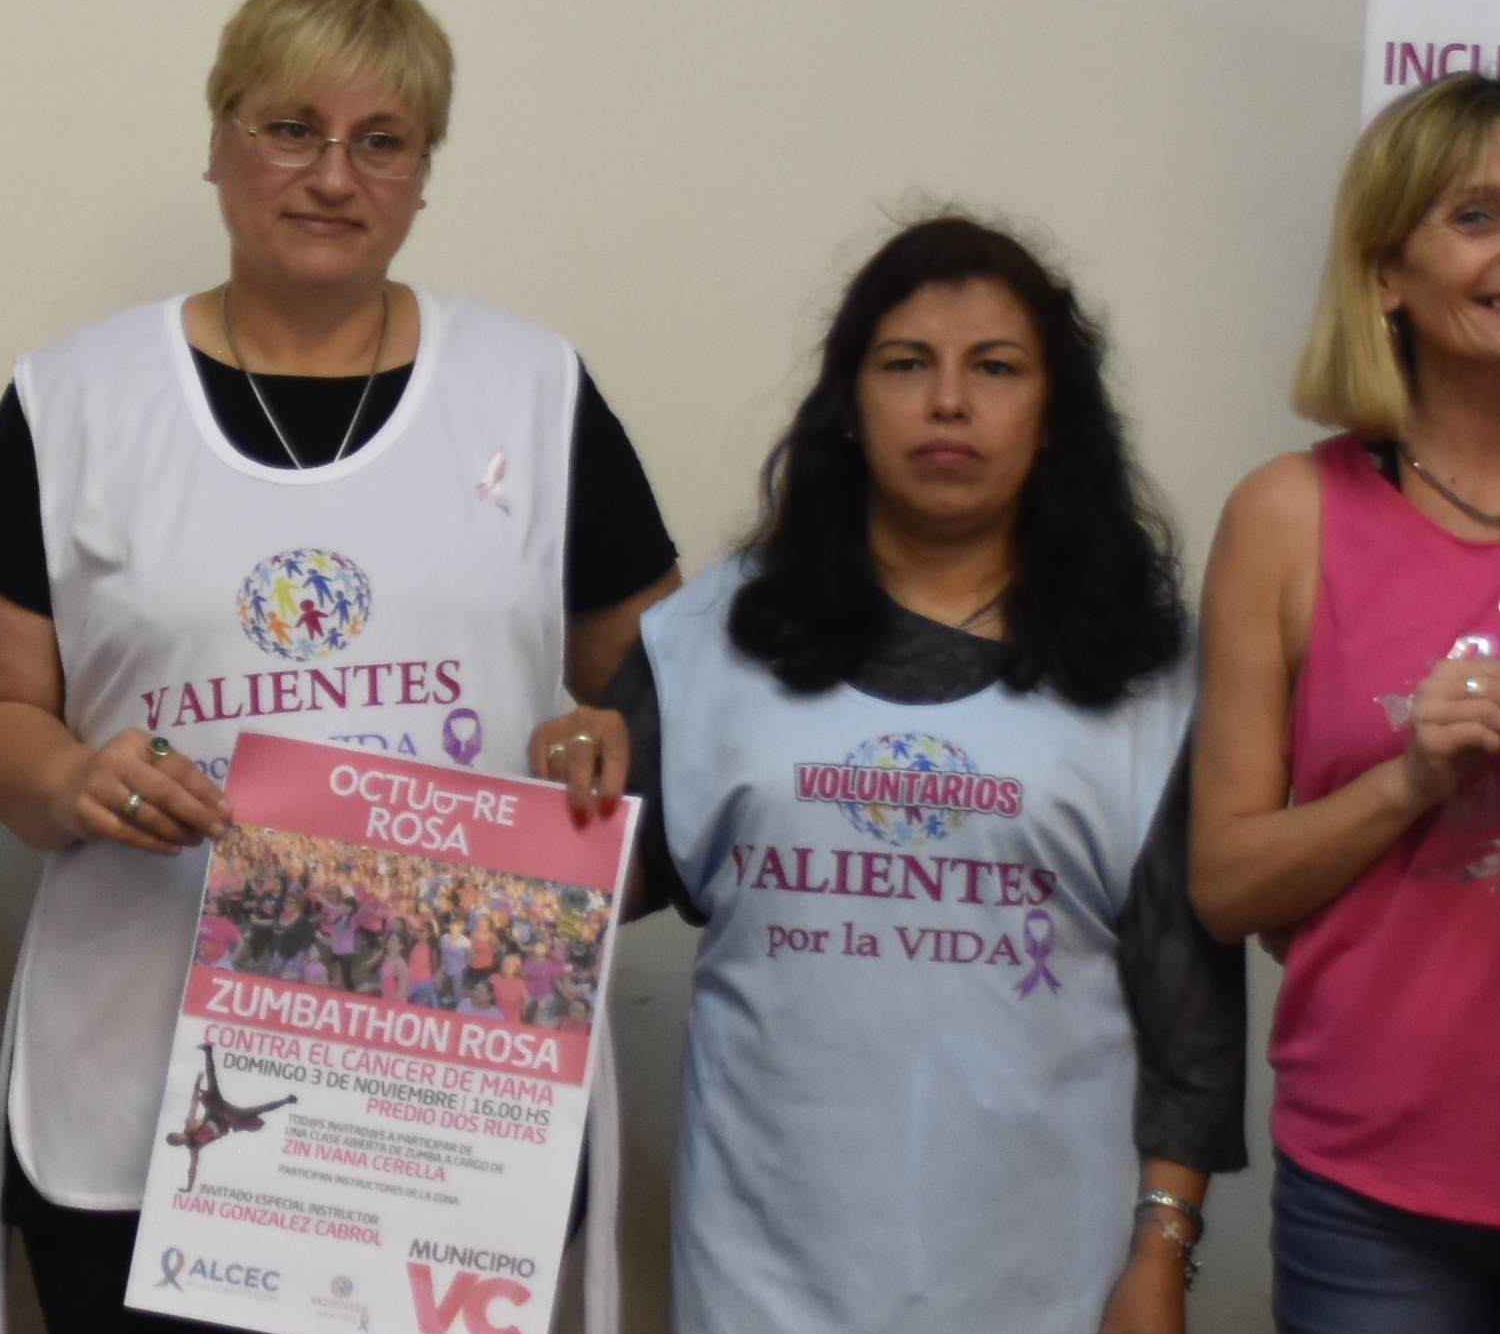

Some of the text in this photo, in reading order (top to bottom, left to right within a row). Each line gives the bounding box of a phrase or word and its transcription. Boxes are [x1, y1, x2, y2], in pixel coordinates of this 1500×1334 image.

[141, 659, 462, 732] VALIENTES
[798, 764, 1021, 815] VOLUNTARIOS
[366, 806, 469, 856] ROSA
[732, 844, 1057, 907] VALIENTES
[767, 921, 1022, 966] por la VIDA
[206, 977, 560, 1073] ZUMBATHON ROSA
[204, 1024, 301, 1062] CONTRA
[308, 1043, 334, 1066] EL
[442, 1066, 474, 1092] DE
[480, 1074, 554, 1106] MAMA
[223, 1052, 550, 1126] DOMINGO 3 DE NOVIEMBRE 16.00 HS
[366, 1097, 547, 1145] PREDIO DOS RUTAS
[282, 1139, 446, 1182] ZIN IVANA CERELLA
[219, 1202, 312, 1234] GONZALEZ
[315, 1219, 383, 1248] CABROL
[189, 1257, 280, 1292] ALCEC
[408, 1238, 536, 1279] MUNICIPIO
